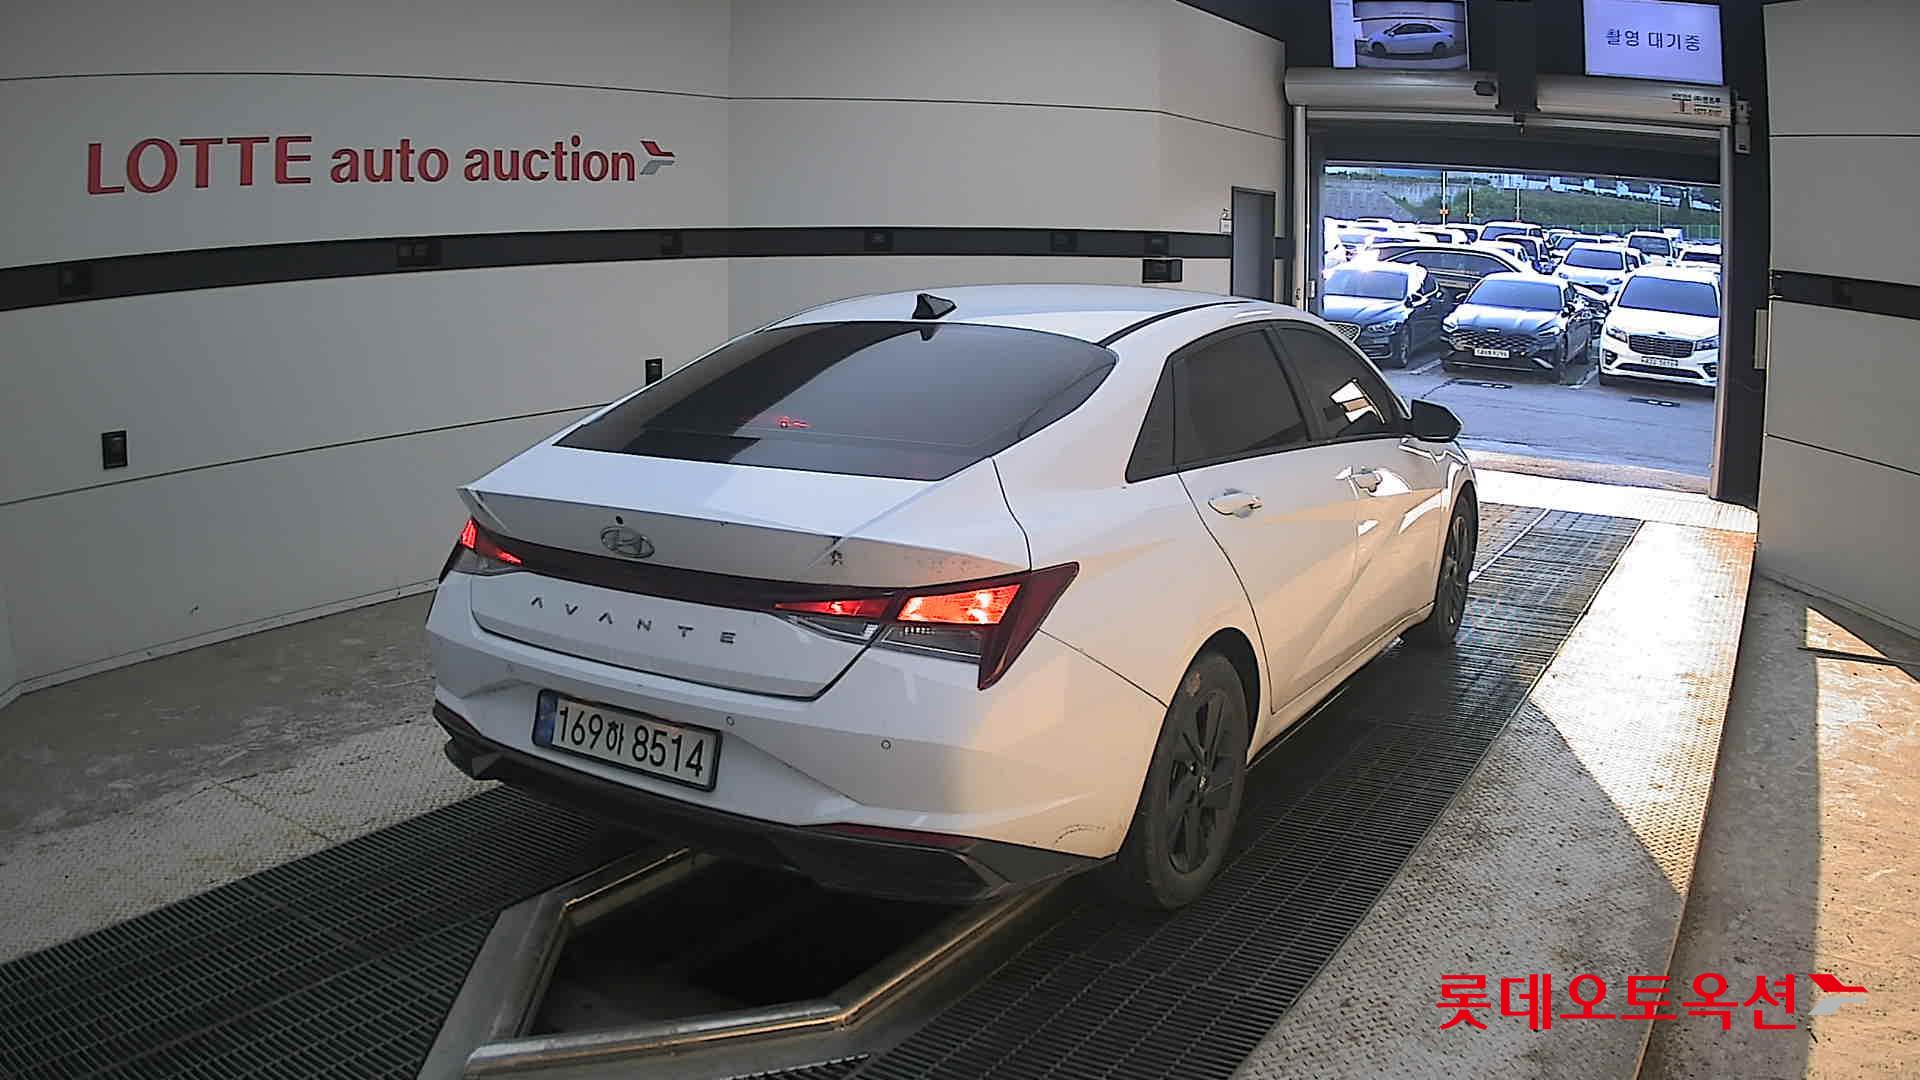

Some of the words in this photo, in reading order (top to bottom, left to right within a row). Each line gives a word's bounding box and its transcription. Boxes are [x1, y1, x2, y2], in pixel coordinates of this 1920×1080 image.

[1647, 31, 1701, 52] 대기중
[87, 134, 313, 196] LOTTE
[329, 137, 450, 184] auto
[463, 134, 637, 183] auction
[530, 596, 737, 645] AVANTE
[559, 706, 625, 756] 169하
[631, 724, 705, 778] 8514
